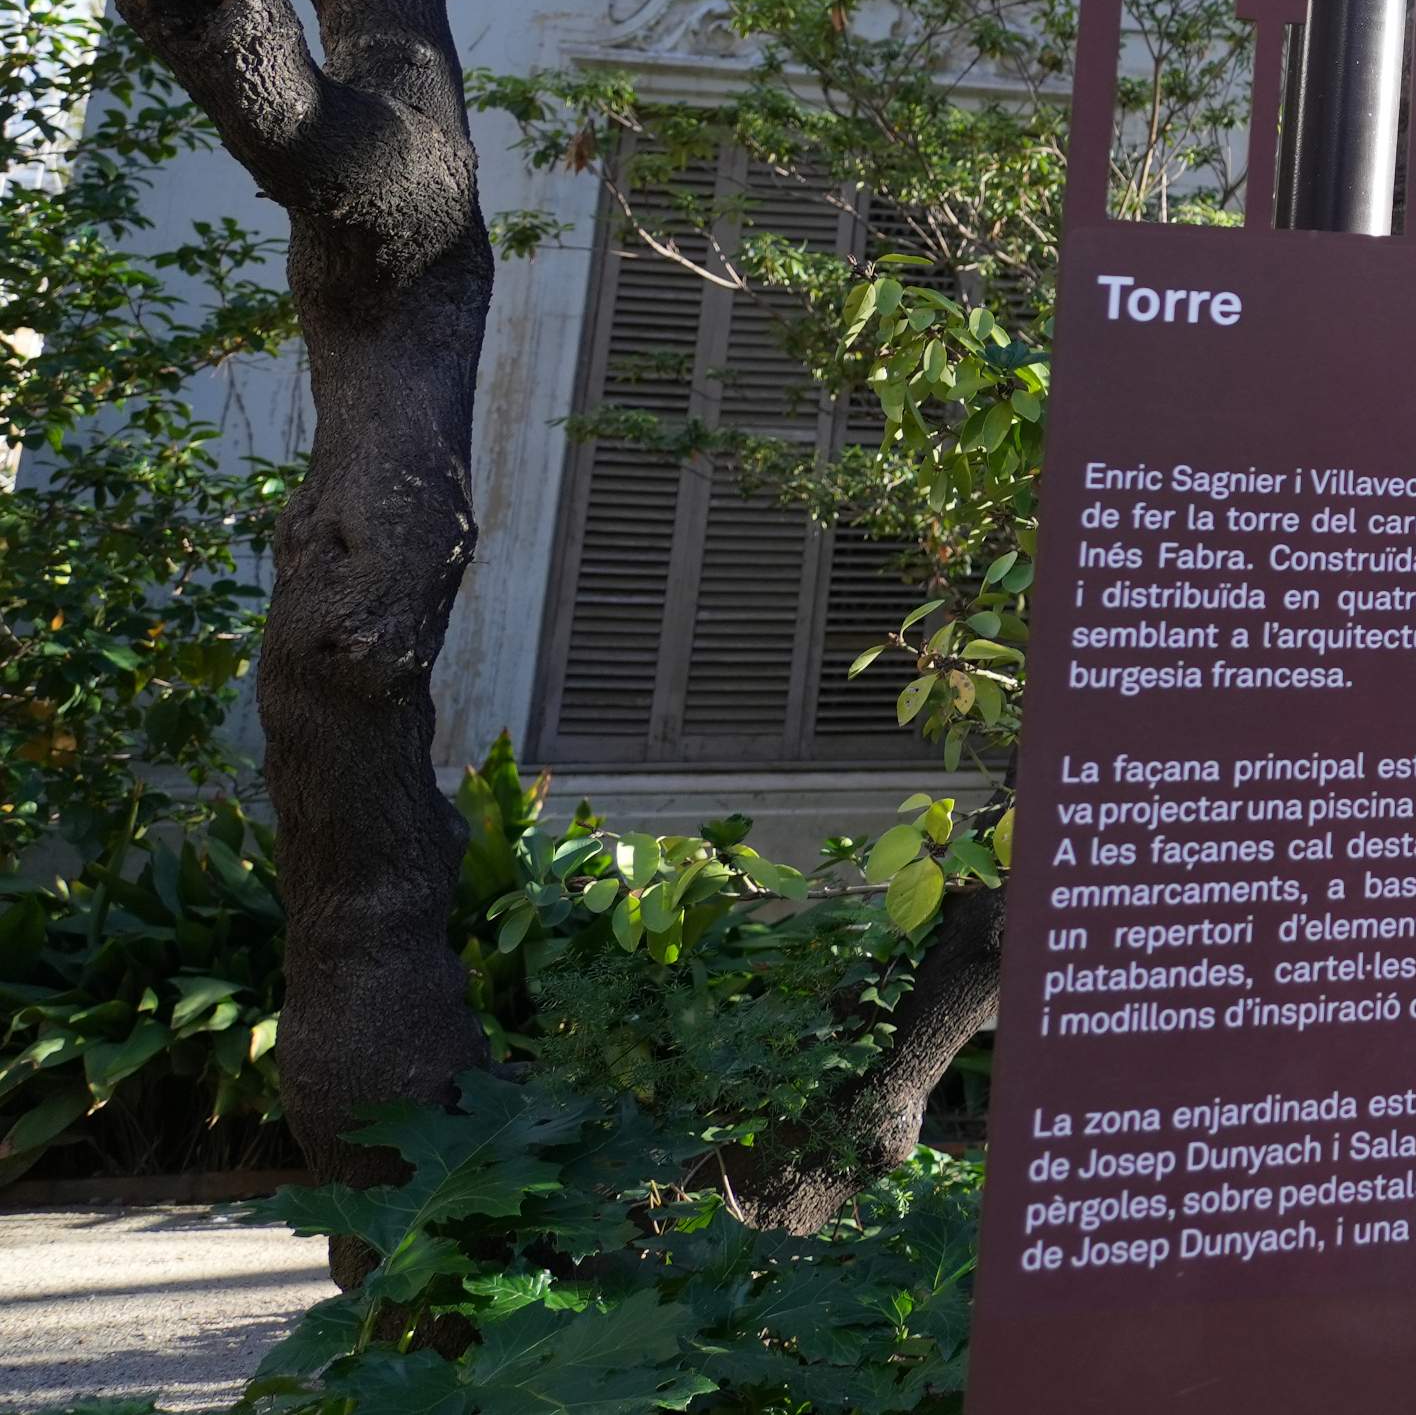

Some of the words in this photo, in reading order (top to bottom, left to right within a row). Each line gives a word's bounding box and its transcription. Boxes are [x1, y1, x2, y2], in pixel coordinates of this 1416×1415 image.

[1097, 274, 1242, 326] Torre
[1085, 462, 1163, 491] Enric
[1171, 464, 1288, 500] Sagnier
[1294, 468, 1302, 494] i
[1081, 501, 1120, 529] de
[1131, 501, 1177, 530] fer
[1187, 503, 1215, 531] la
[1226, 507, 1300, 533] torre
[1311, 506, 1357, 534] del
[1079, 540, 1143, 569] Inés
[1158, 542, 1254, 570] Fabra.
[1075, 580, 1084, 607] i
[1101, 580, 1266, 610] distribuïda
[1283, 589, 1320, 610] en
[1071, 620, 1220, 649] semblant
[1230, 627, 1250, 649] a
[1069, 660, 1203, 697] burgesia
[1211, 660, 1353, 688] francesa.
[1061, 755, 1100, 784] La
[1113, 753, 1220, 789] façana
[1233, 751, 1366, 788] principal
[1057, 802, 1094, 825] va
[1098, 794, 1244, 831] projectar
[1247, 799, 1303, 821] una
[1308, 790, 1414, 827] piscina
[1052, 837, 1077, 866] A
[1090, 836, 1137, 866] les
[1150, 834, 1275, 870] façanes
[1287, 831, 1334, 861] cal
[1050, 875, 1308, 909] emmarcaments,
[1327, 878, 1346, 900] a
[1048, 927, 1088, 951] un
[1114, 915, 1253, 955] repertori
[1044, 958, 1253, 1001] platabandes,
[1274, 951, 1416, 984] cartel·les
[1041, 1006, 1050, 1036] i
[1060, 1002, 1216, 1035] modillons
[1224, 992, 1401, 1032] d’inspiració
[1033, 1108, 1073, 1138] La
[1083, 1108, 1161, 1135] zona
[1172, 1090, 1358, 1135] enjardinada
[1028, 1151, 1070, 1182] de
[1078, 1148, 1176, 1181] Josep
[1186, 1134, 1322, 1175] Dunyach
[1332, 1132, 1340, 1161] i
[1349, 1129, 1416, 1161] Sala
[1025, 1189, 1176, 1235] pèrgoles,
[1182, 1182, 1273, 1215] sobre
[1021, 1239, 1064, 1271] de
[1071, 1236, 1170, 1269] Josep
[1180, 1219, 1325, 1261] Dunyach,
[1336, 1216, 1344, 1246] i
[1353, 1219, 1410, 1245] una
